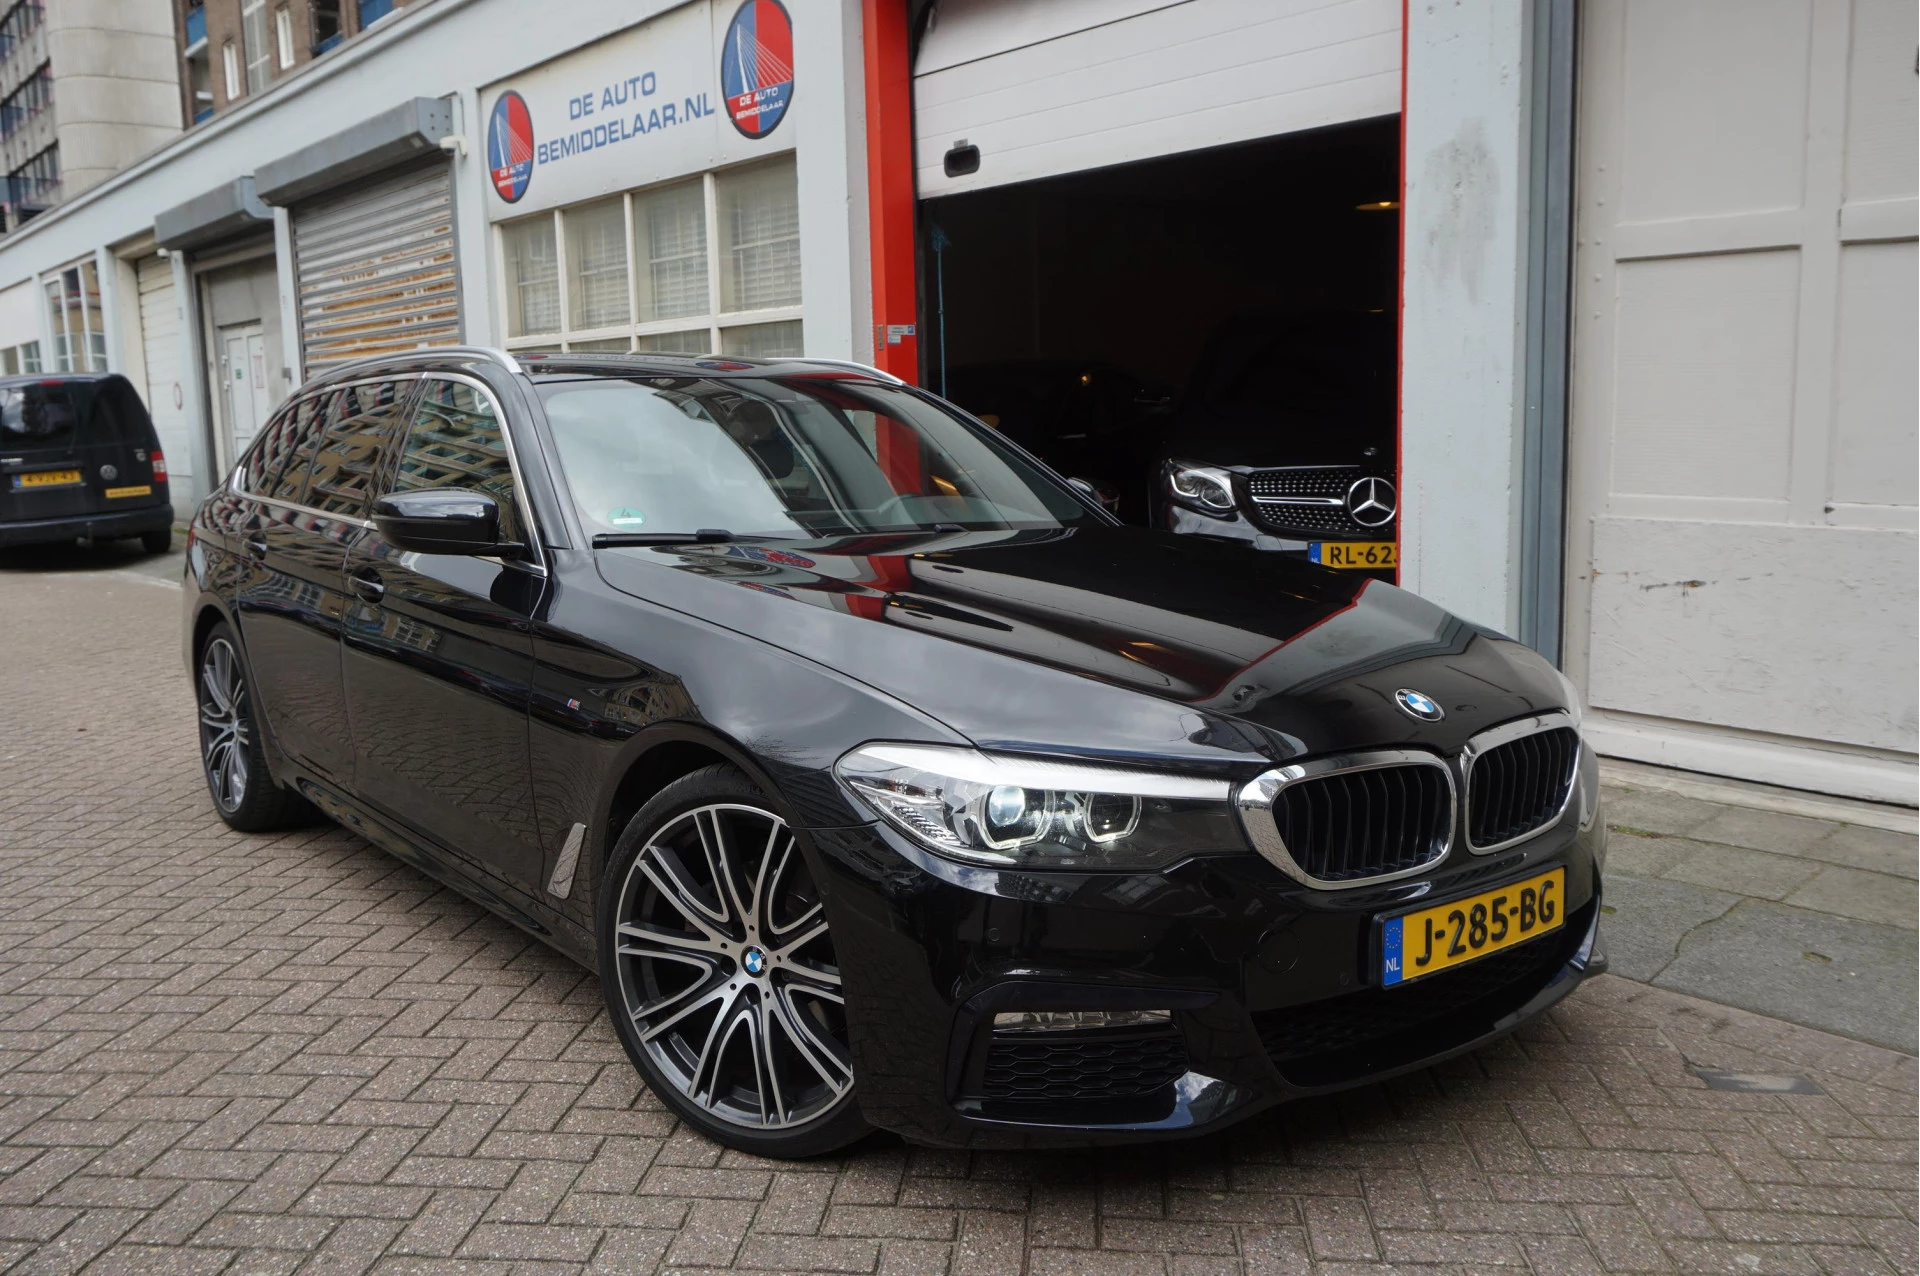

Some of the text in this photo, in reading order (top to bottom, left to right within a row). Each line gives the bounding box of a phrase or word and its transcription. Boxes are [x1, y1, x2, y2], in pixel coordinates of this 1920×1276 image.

[569, 71, 657, 121] DE AUTO
[739, 86, 779, 107] DE AUTO
[537, 92, 715, 165] BEMIDDELAAR.NL
[1330, 546, 1397, 565] RL-62
[1415, 879, 1555, 967] J-285-BG
[1385, 957, 1401, 973] NL
